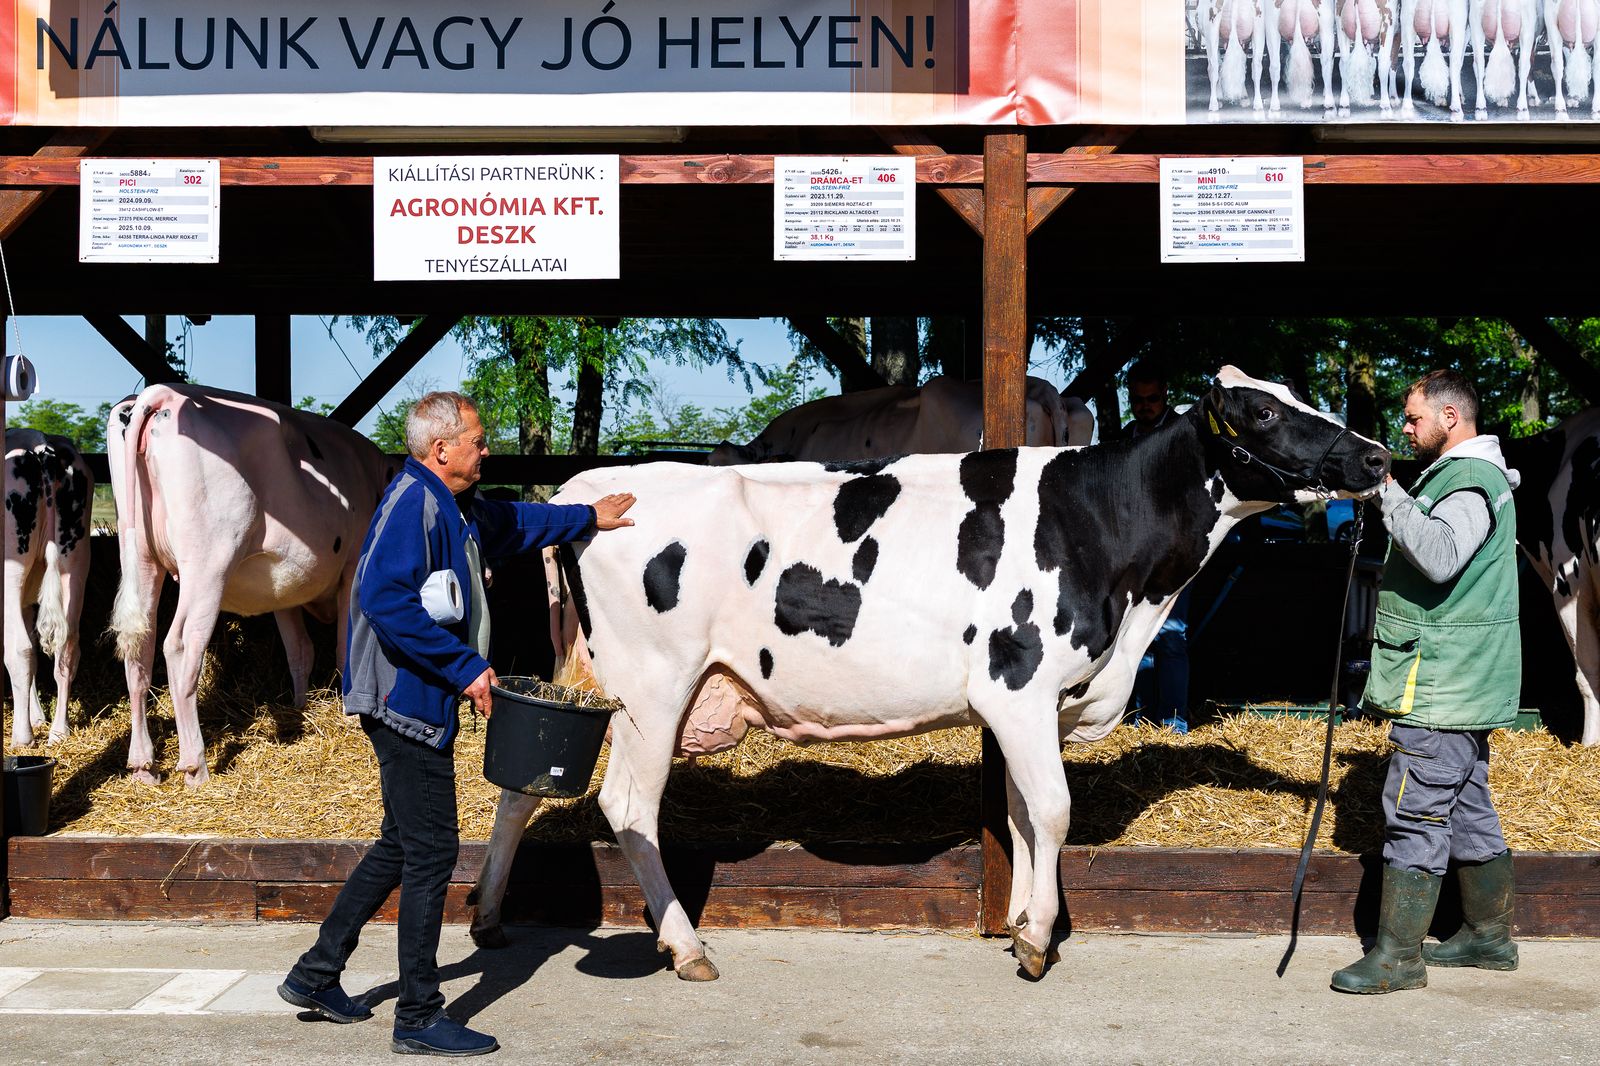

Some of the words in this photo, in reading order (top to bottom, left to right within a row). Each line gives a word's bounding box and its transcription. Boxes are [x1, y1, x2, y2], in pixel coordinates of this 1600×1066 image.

[36, 0, 319, 71] NÁLUNK
[339, 16, 523, 71] VAGY
[540, 0, 632, 71] JÓ
[657, 14, 935, 70] HELYEN!
[184, 175, 202, 185] 302
[388, 164, 474, 182] KIÁLLÍTÁSI
[480, 163, 595, 181] PARTNERÜNK
[810, 176, 863, 184] DRÁMCA-ET
[877, 174, 896, 182] 406
[1265, 173, 1283, 182] 610
[390, 192, 546, 217] AGRONÓMIA
[554, 196, 604, 216] KFT.
[458, 226, 536, 244] DESZK
[425, 256, 567, 273] TENYÉSZÁLLATAI
